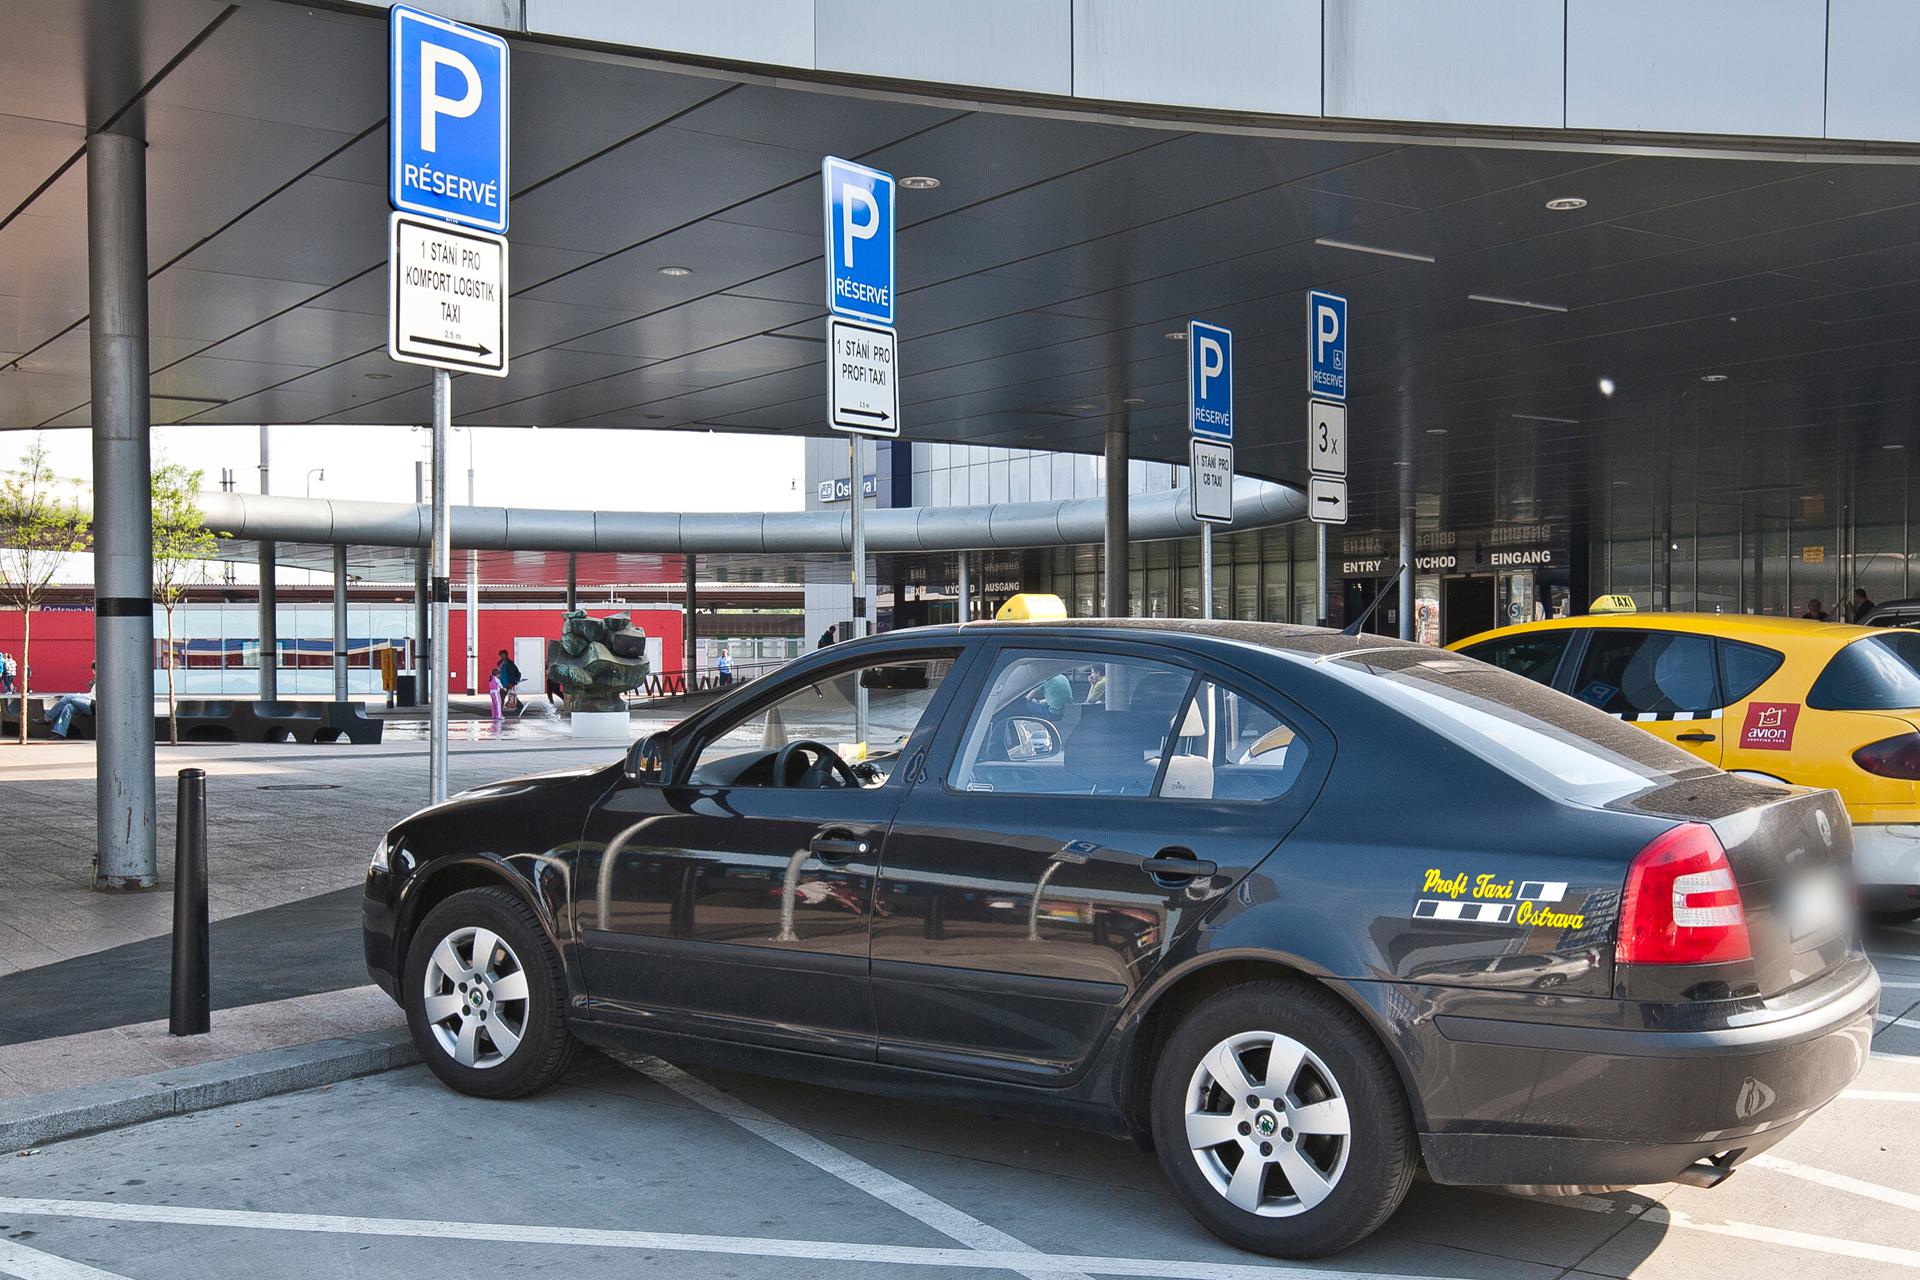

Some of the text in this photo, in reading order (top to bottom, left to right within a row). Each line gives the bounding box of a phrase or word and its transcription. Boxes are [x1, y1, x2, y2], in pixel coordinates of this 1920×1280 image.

[420, 40, 483, 153] P
[404, 163, 497, 207] RÉSERVÉ
[842, 182, 880, 268] P
[421, 240, 481, 271] 1 STÁNÍ PRO
[405, 266, 495, 302] KOMFORT LOGISTIK
[836, 276, 889, 306] RÉSERVÉ
[441, 302, 461, 323] TAXI
[1317, 304, 1339, 363] P
[837, 338, 890, 364] 1 STÁNÍ PRO
[842, 363, 886, 386] PROFI TAXI
[1200, 336, 1224, 400] P
[1313, 368, 1344, 388] RÉSERVÉ
[1195, 405, 1230, 427] RÉSERVÉ
[1201, 453, 1217, 469] STÁNÍ
[1218, 457, 1229, 472] PRO
[1211, 474, 1223, 488] TAXI
[1343, 560, 1381, 574] ENTRY
[1415, 555, 1456, 569] VCHOD
[1491, 550, 1551, 566] EINGANG
[945, 582, 975, 594] VÝCD
[985, 582, 1020, 593] AUSGANG
[1611, 596, 1633, 608] TAXI
[1748, 728, 1786, 739] avion
[1423, 868, 1515, 899] Profi Taxi
[1516, 900, 1585, 930] Ostrava
